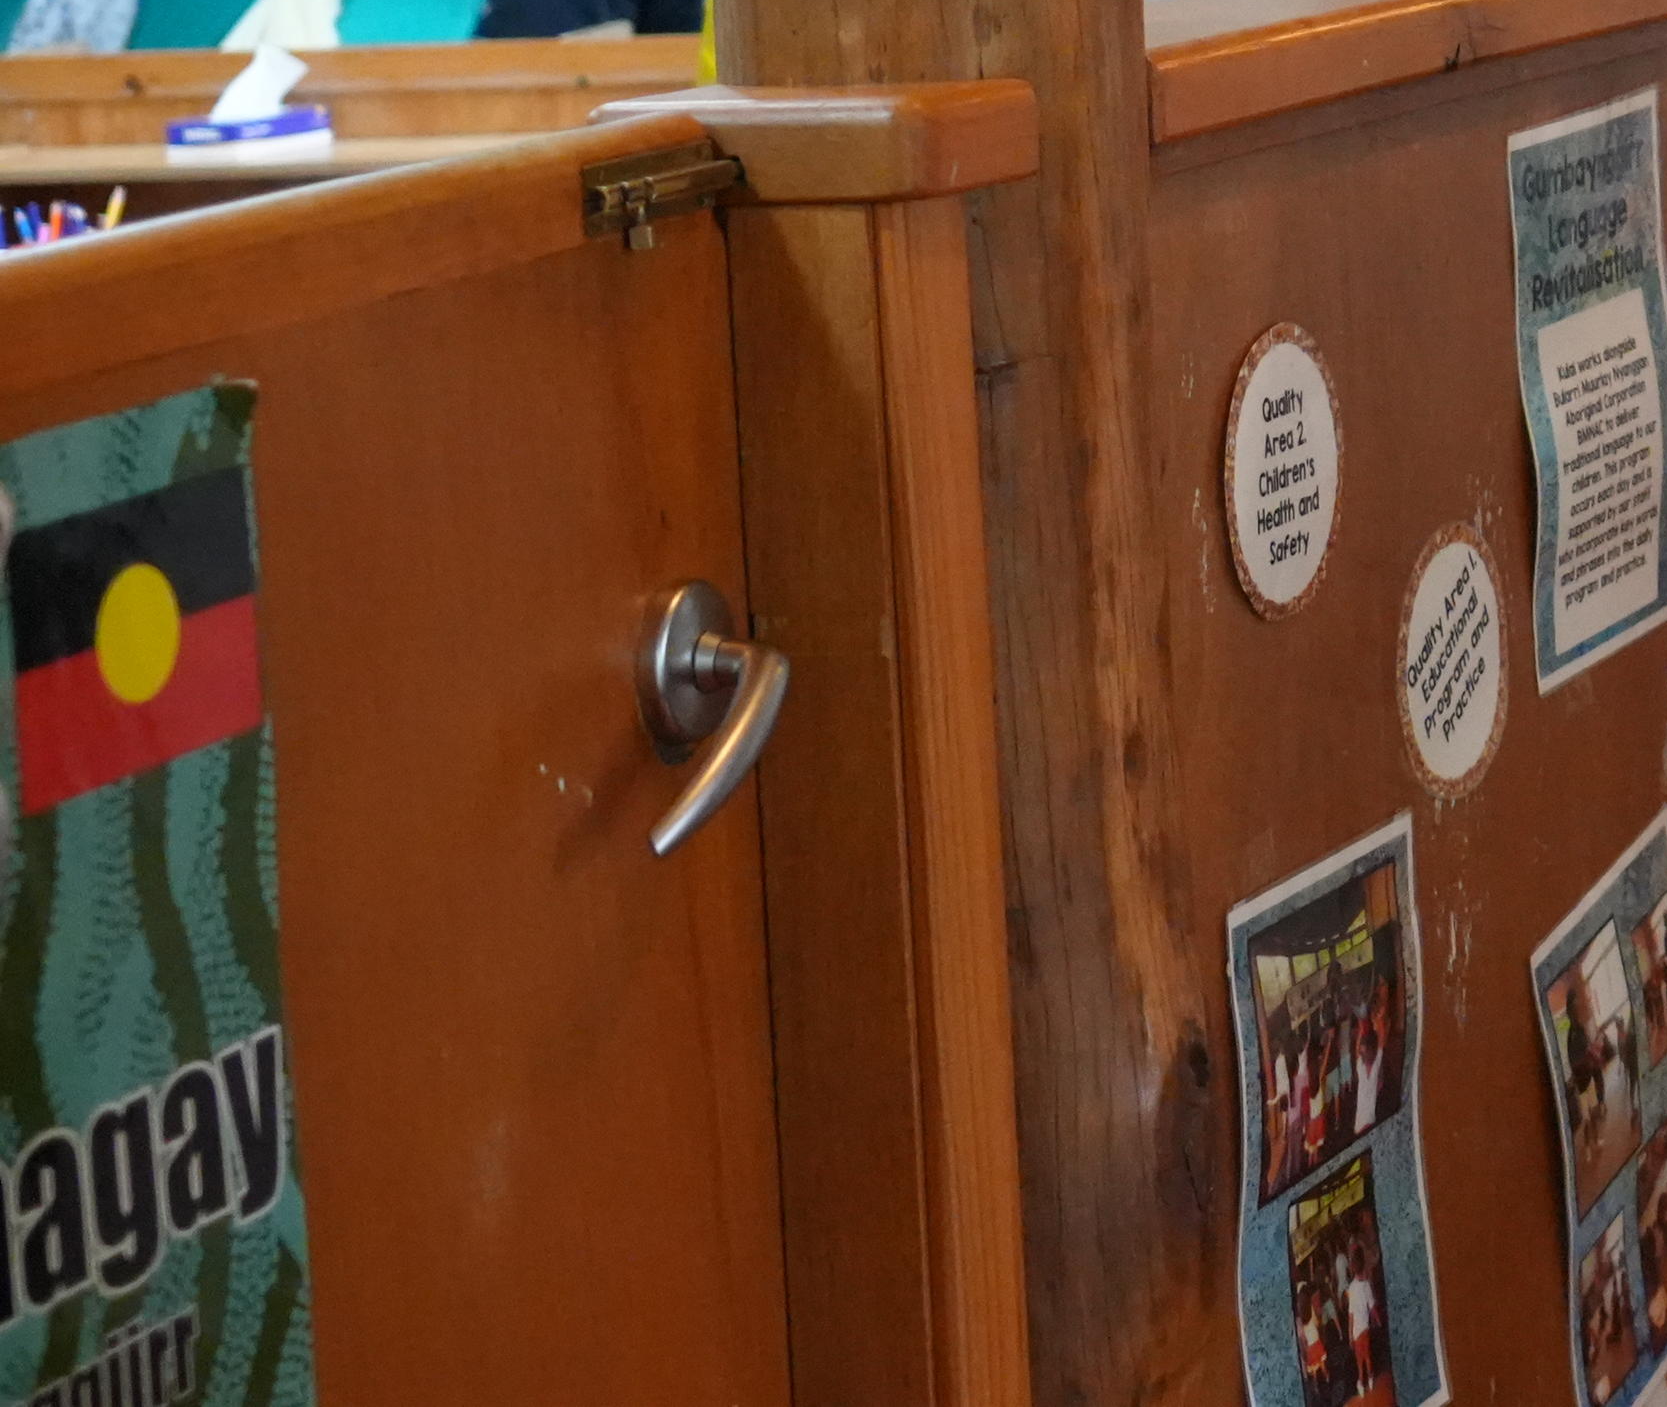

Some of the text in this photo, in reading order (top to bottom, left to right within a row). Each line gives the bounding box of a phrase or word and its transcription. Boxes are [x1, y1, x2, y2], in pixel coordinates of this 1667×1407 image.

[1548, 197, 1628, 254] Language
[1532, 244, 1644, 312] Revitalisation
[1577, 352, 1602, 373] works
[1603, 336, 1636, 361] alongside
[1262, 387, 1304, 423] Quality
[1565, 381, 1646, 426] Aboriginal Corporation
[1605, 418, 1614, 432] to
[1615, 406, 1640, 427] deliver
[1264, 421, 1307, 459] Area 2.
[1563, 443, 1601, 474] traditional
[1602, 431, 1634, 456] language
[1619, 446, 1650, 473] program
[1258, 457, 1316, 498] Children's
[1570, 494, 1595, 517] occurs
[1597, 484, 1615, 504] each
[1616, 479, 1630, 495] day
[1631, 469, 1645, 487] and
[1257, 485, 1321, 535] Health and
[1568, 510, 1606, 540] supported
[1618, 498, 1632, 515] our
[1269, 530, 1310, 565] Safety
[1559, 548, 1574, 566] who
[1575, 525, 1619, 558] incorporate
[1635, 504, 1658, 526] words
[1560, 566, 1575, 587] and
[1575, 553, 1606, 581] phrases
[1565, 579, 1600, 610] program
[1600, 567, 1615, 588] and
[1407, 617, 1444, 688] Quality
[1444, 566, 1471, 620] Area
[1421, 586, 1479, 704] Educational
[1424, 603, 1490, 739] Program and
[1442, 656, 1486, 743] Practice
[0, 1026, 281, 1330] agay
